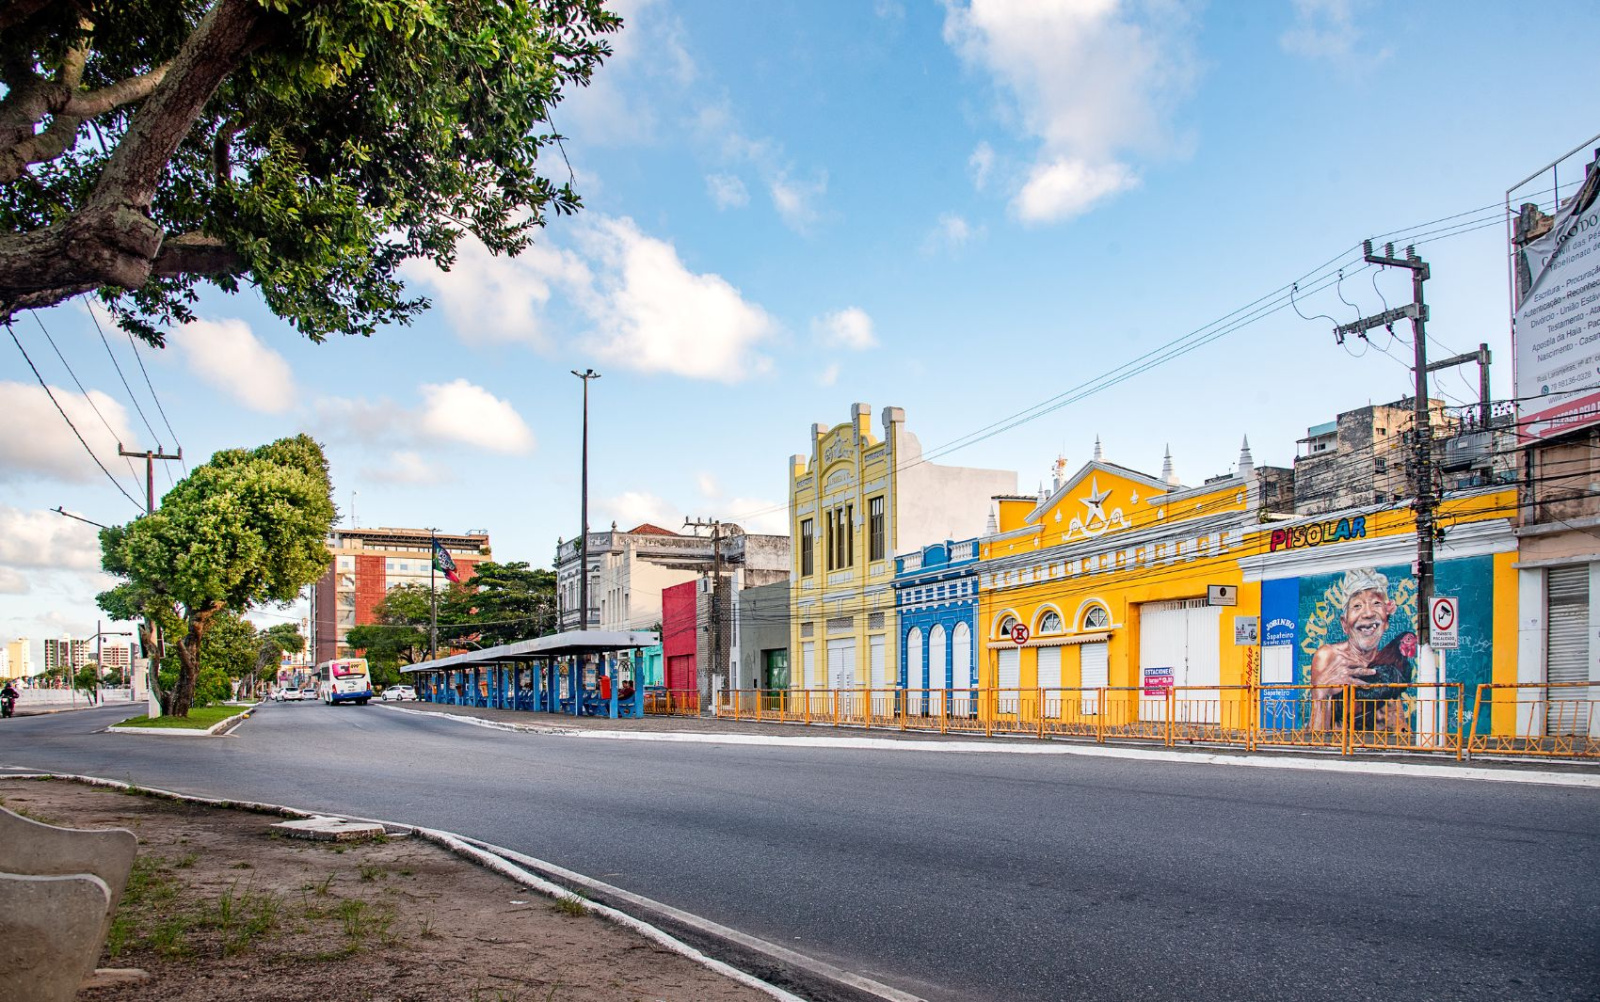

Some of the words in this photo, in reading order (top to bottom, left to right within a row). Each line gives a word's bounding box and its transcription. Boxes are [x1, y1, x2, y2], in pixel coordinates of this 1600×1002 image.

[1580, 214, 1598, 232] DO
[1534, 285, 1560, 302] Escritura
[1523, 297, 1562, 319] Autenticação
[1530, 312, 1555, 329] Divórcio
[1560, 301, 1580, 315] União
[1547, 312, 1584, 333] Testamento
[1532, 337, 1556, 353] Apostila
[1556, 334, 1565, 342] da
[1566, 326, 1582, 338] Haia
[1537, 343, 1574, 363] Nascimento
[1536, 375, 1548, 383] Rua
[1551, 383, 1558, 391] 79
[1580, 402, 1596, 420] PELO
[1270, 516, 1366, 552] PISOLAR
[1266, 618, 1295, 631] JOBINHO
[1266, 631, 1294, 641] Sapateiro
[1263, 689, 1290, 697] Sapateiro
